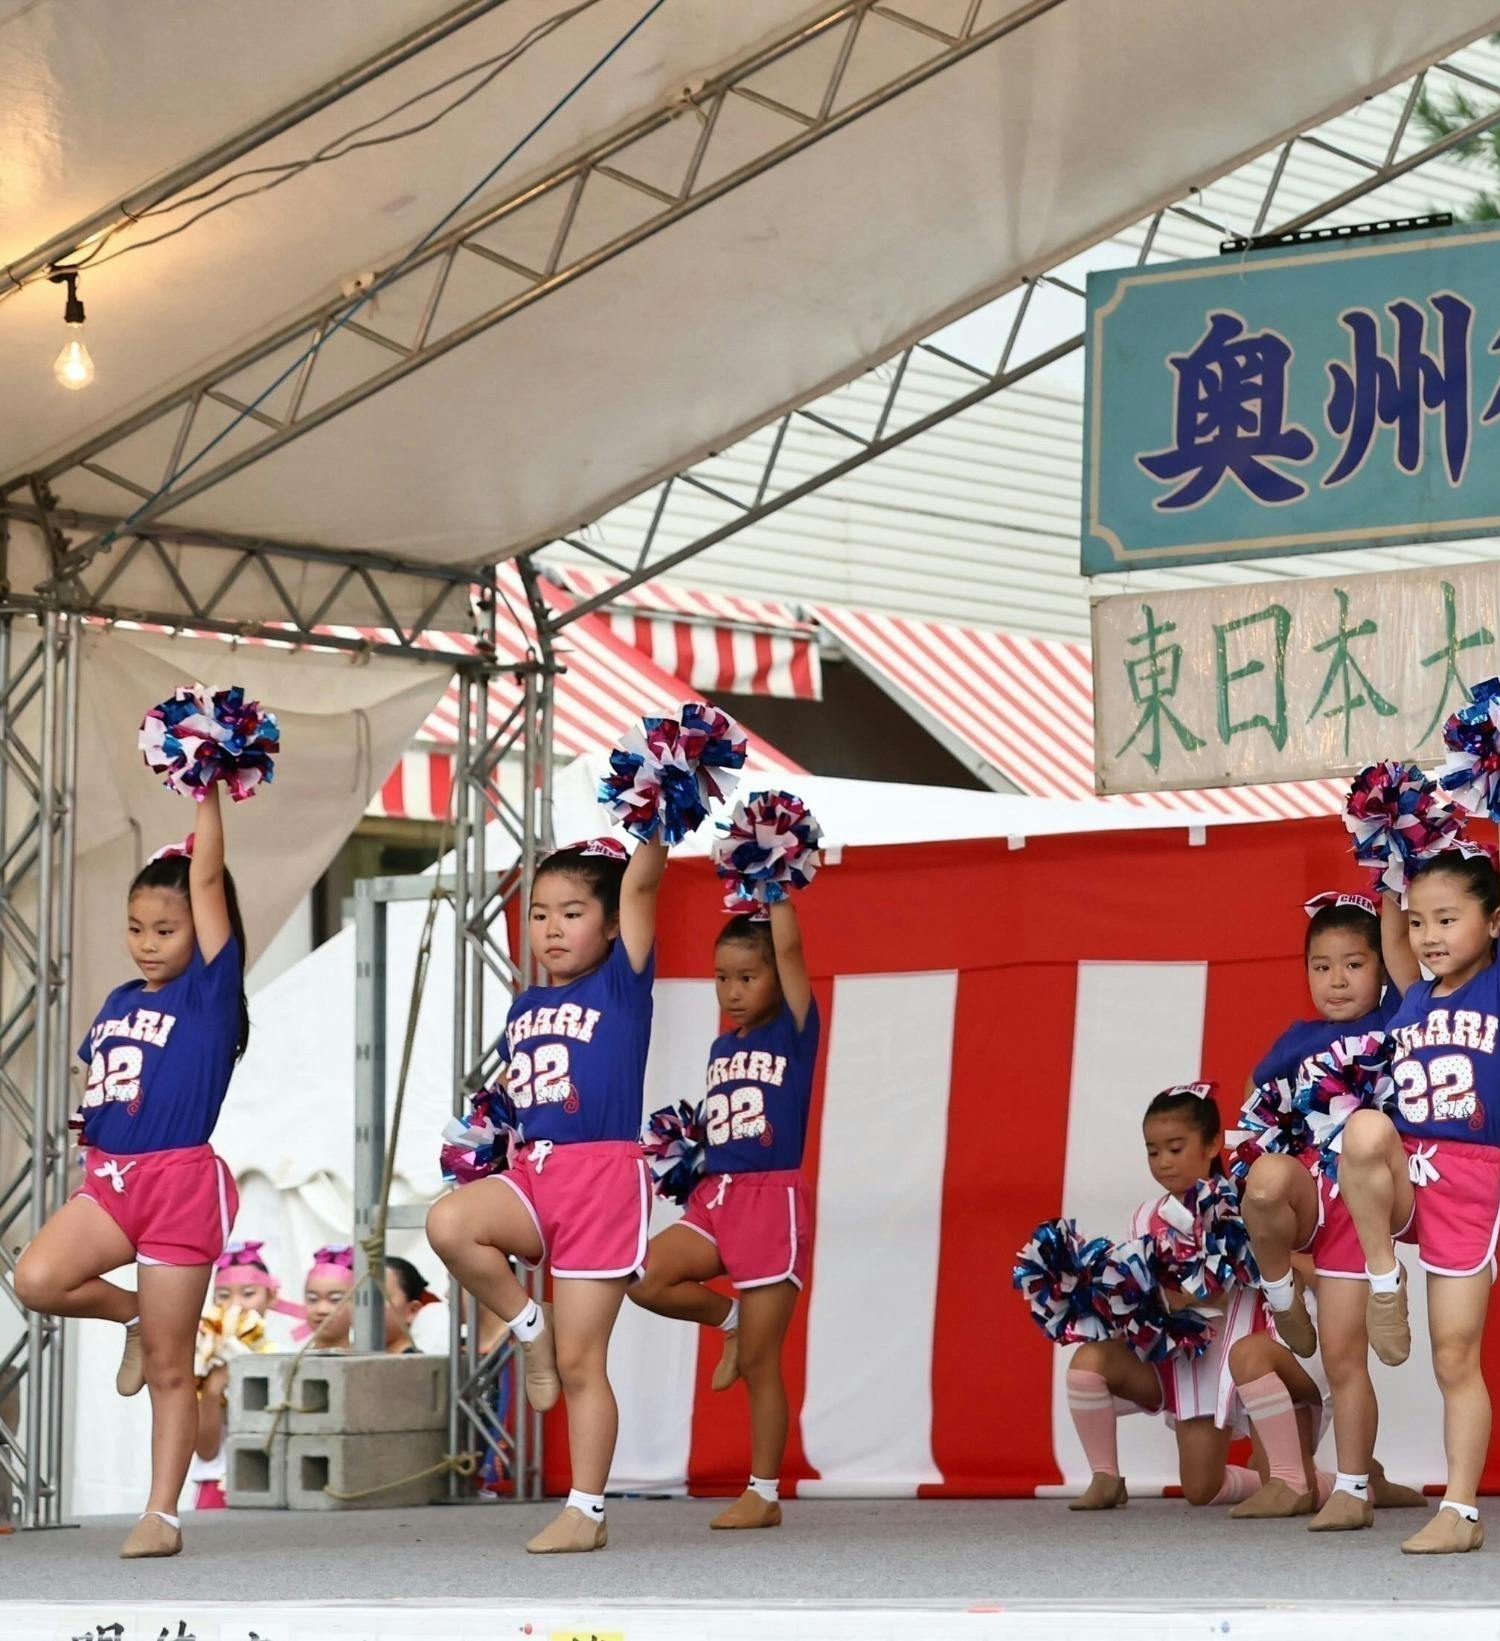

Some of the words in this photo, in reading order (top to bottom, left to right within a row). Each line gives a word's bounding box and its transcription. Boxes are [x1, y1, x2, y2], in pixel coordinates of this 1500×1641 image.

[90, 1008, 176, 1058] IRARI
[506, 1003, 601, 1060] IRARI
[506, 1043, 571, 1109] 22
[706, 1050, 787, 1092] IRARI
[1393, 1054, 1475, 1123] 22
[706, 1086, 765, 1146] 22
